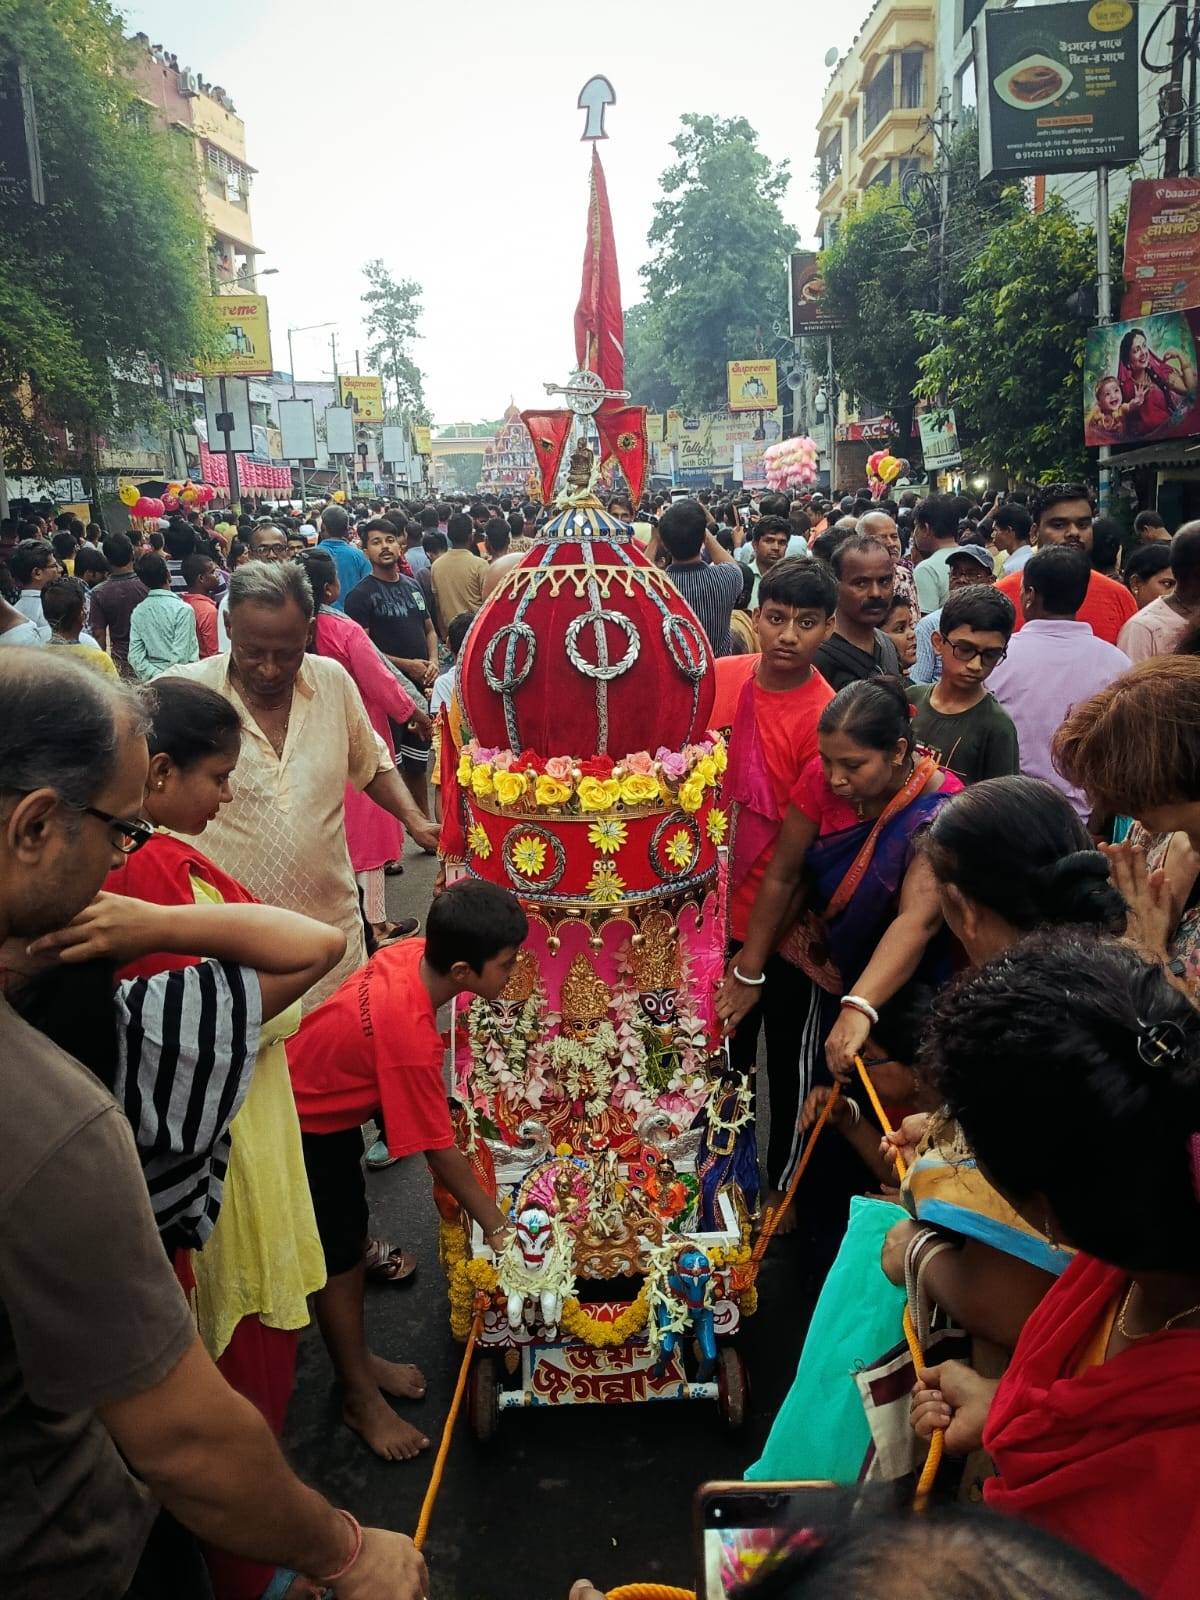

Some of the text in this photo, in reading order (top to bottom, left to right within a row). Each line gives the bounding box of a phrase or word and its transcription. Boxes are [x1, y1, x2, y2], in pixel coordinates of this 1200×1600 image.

[732, 362, 772, 375] Supreme
[343, 377, 377, 389] Supreme
[682, 440, 704, 455] Tally
